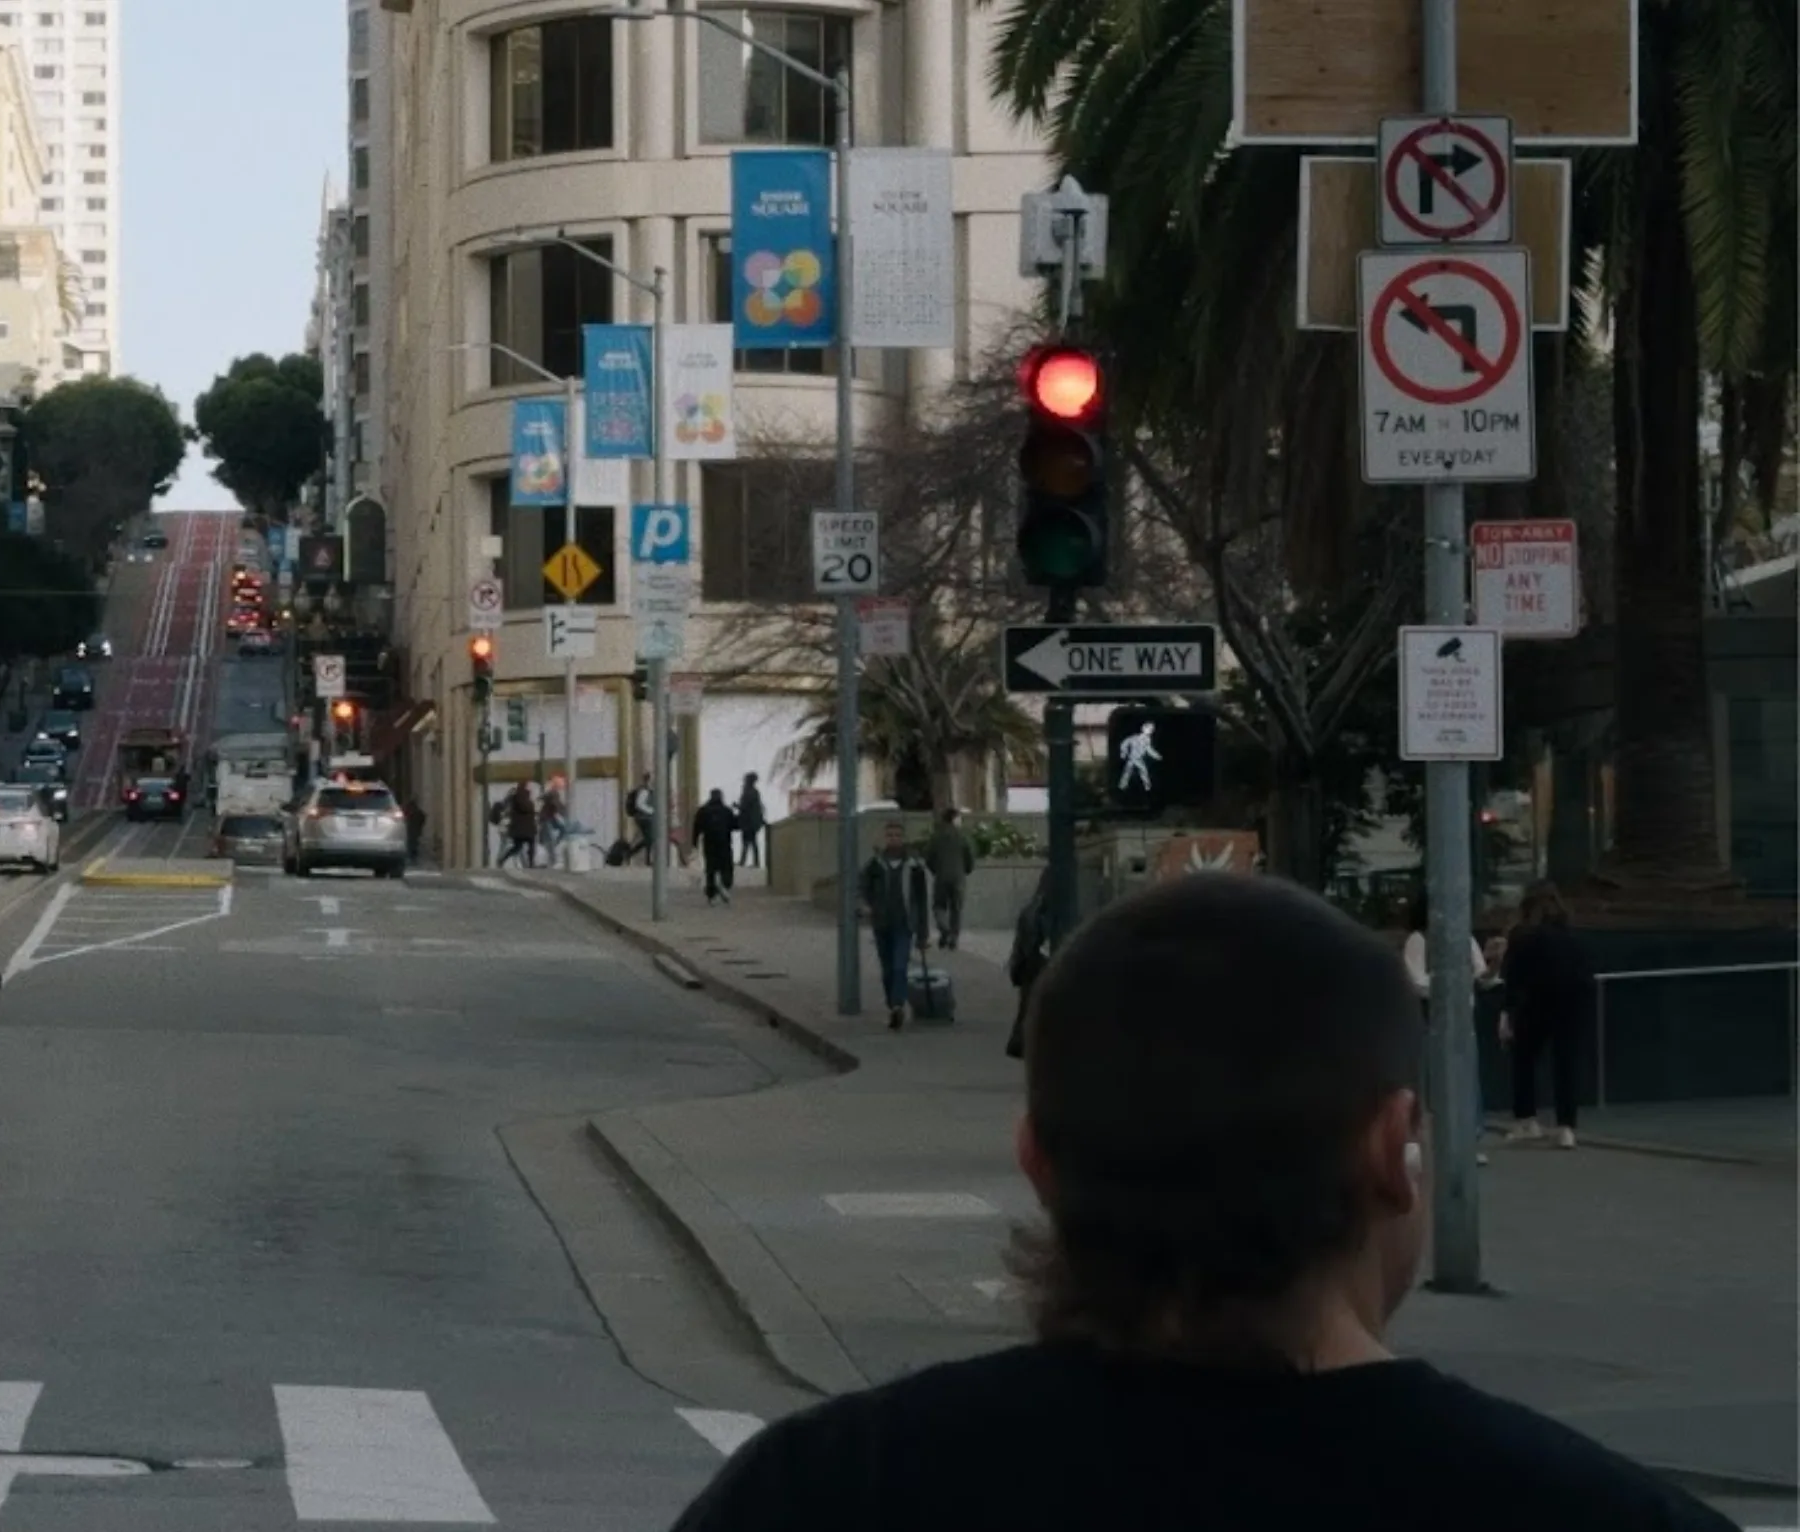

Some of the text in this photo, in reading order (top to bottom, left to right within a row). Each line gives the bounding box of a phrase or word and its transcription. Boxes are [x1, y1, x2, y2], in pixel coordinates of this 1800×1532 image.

[1373, 409, 1426, 433] 7AM
[1462, 408, 1520, 433] 10PM
[1399, 449, 1497, 466] EVERYDAY
[818, 519, 874, 534] SPEED
[823, 537, 867, 550] LIMIT
[1477, 542, 1572, 567] NO STOPPING
[821, 553, 872, 583] 20
[1505, 572, 1542, 590] ANY
[1504, 592, 1546, 612] TIME
[1067, 646, 1193, 673] ONE WAY
